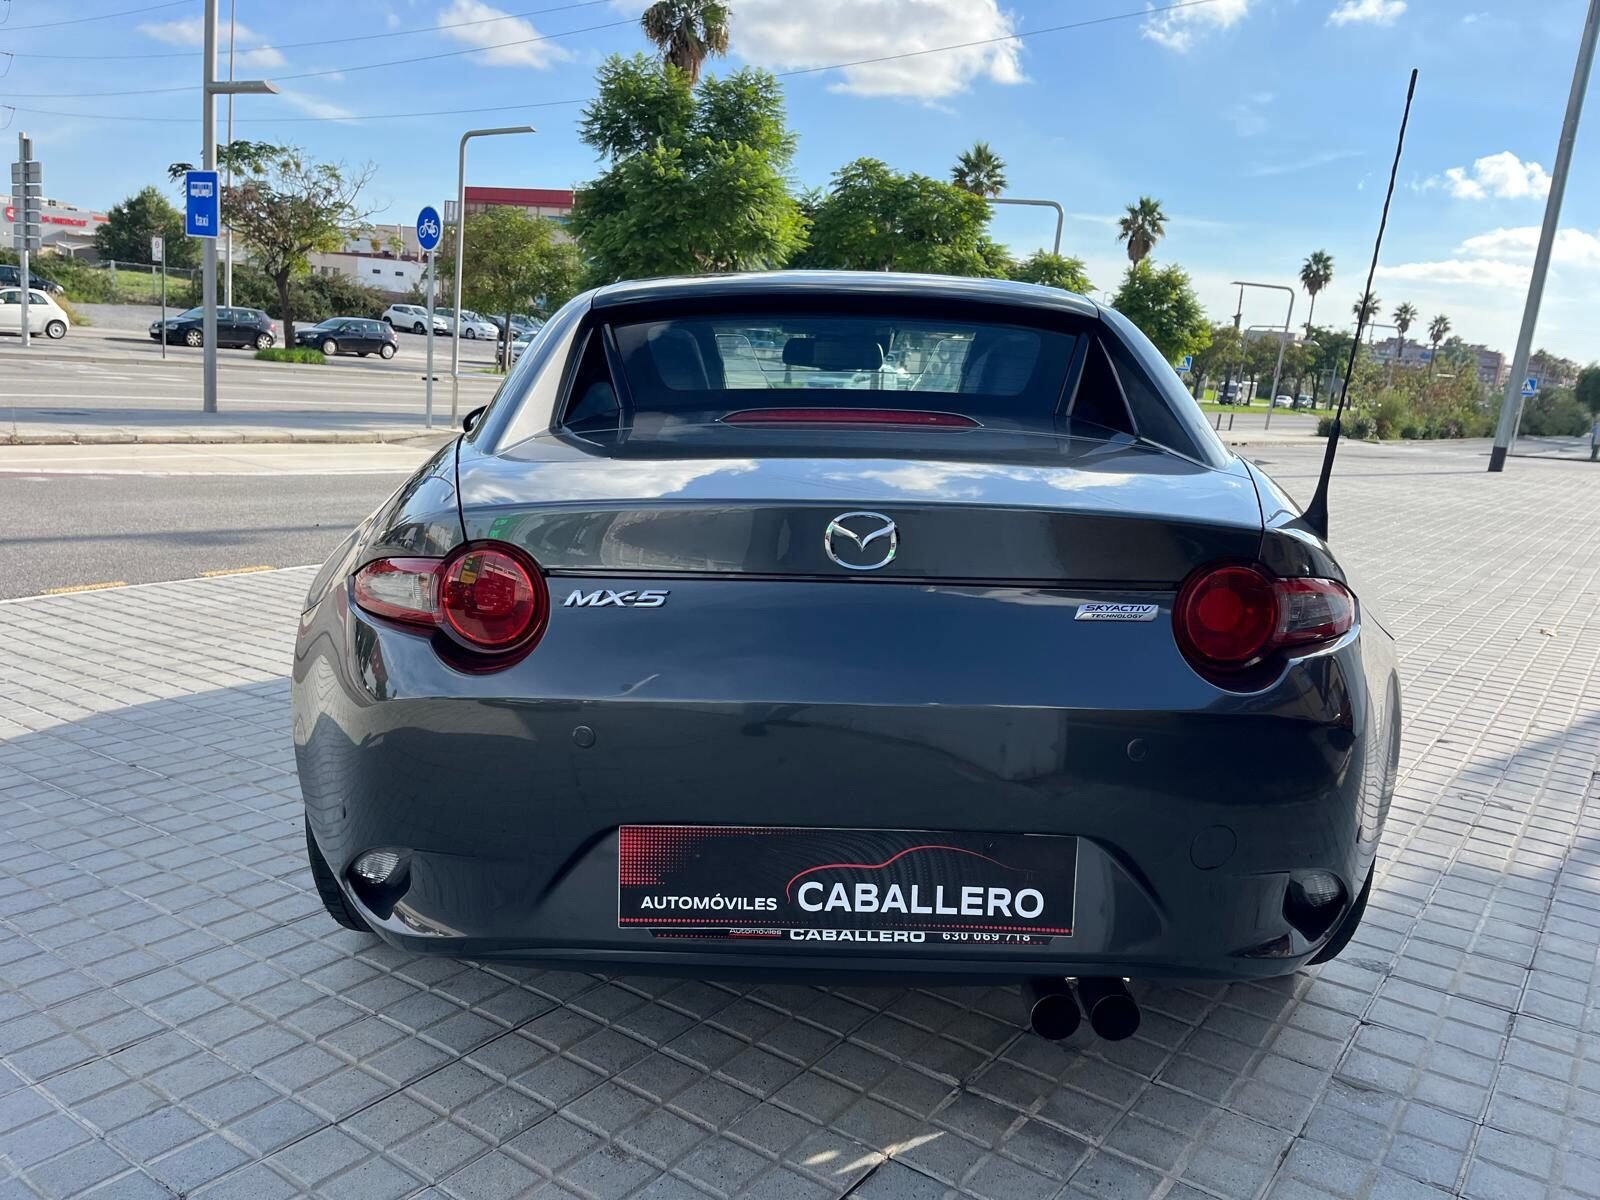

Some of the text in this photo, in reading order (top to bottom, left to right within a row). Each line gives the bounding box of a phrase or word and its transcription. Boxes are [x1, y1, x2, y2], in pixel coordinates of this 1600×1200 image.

[195, 213, 209, 226] taxi
[563, 589, 671, 607] MX-5
[1084, 604, 1152, 613] SKYACTIV
[640, 881, 1045, 919] AUTOMÓVILES CABALLERO
[789, 929, 926, 943] CABALLERO
